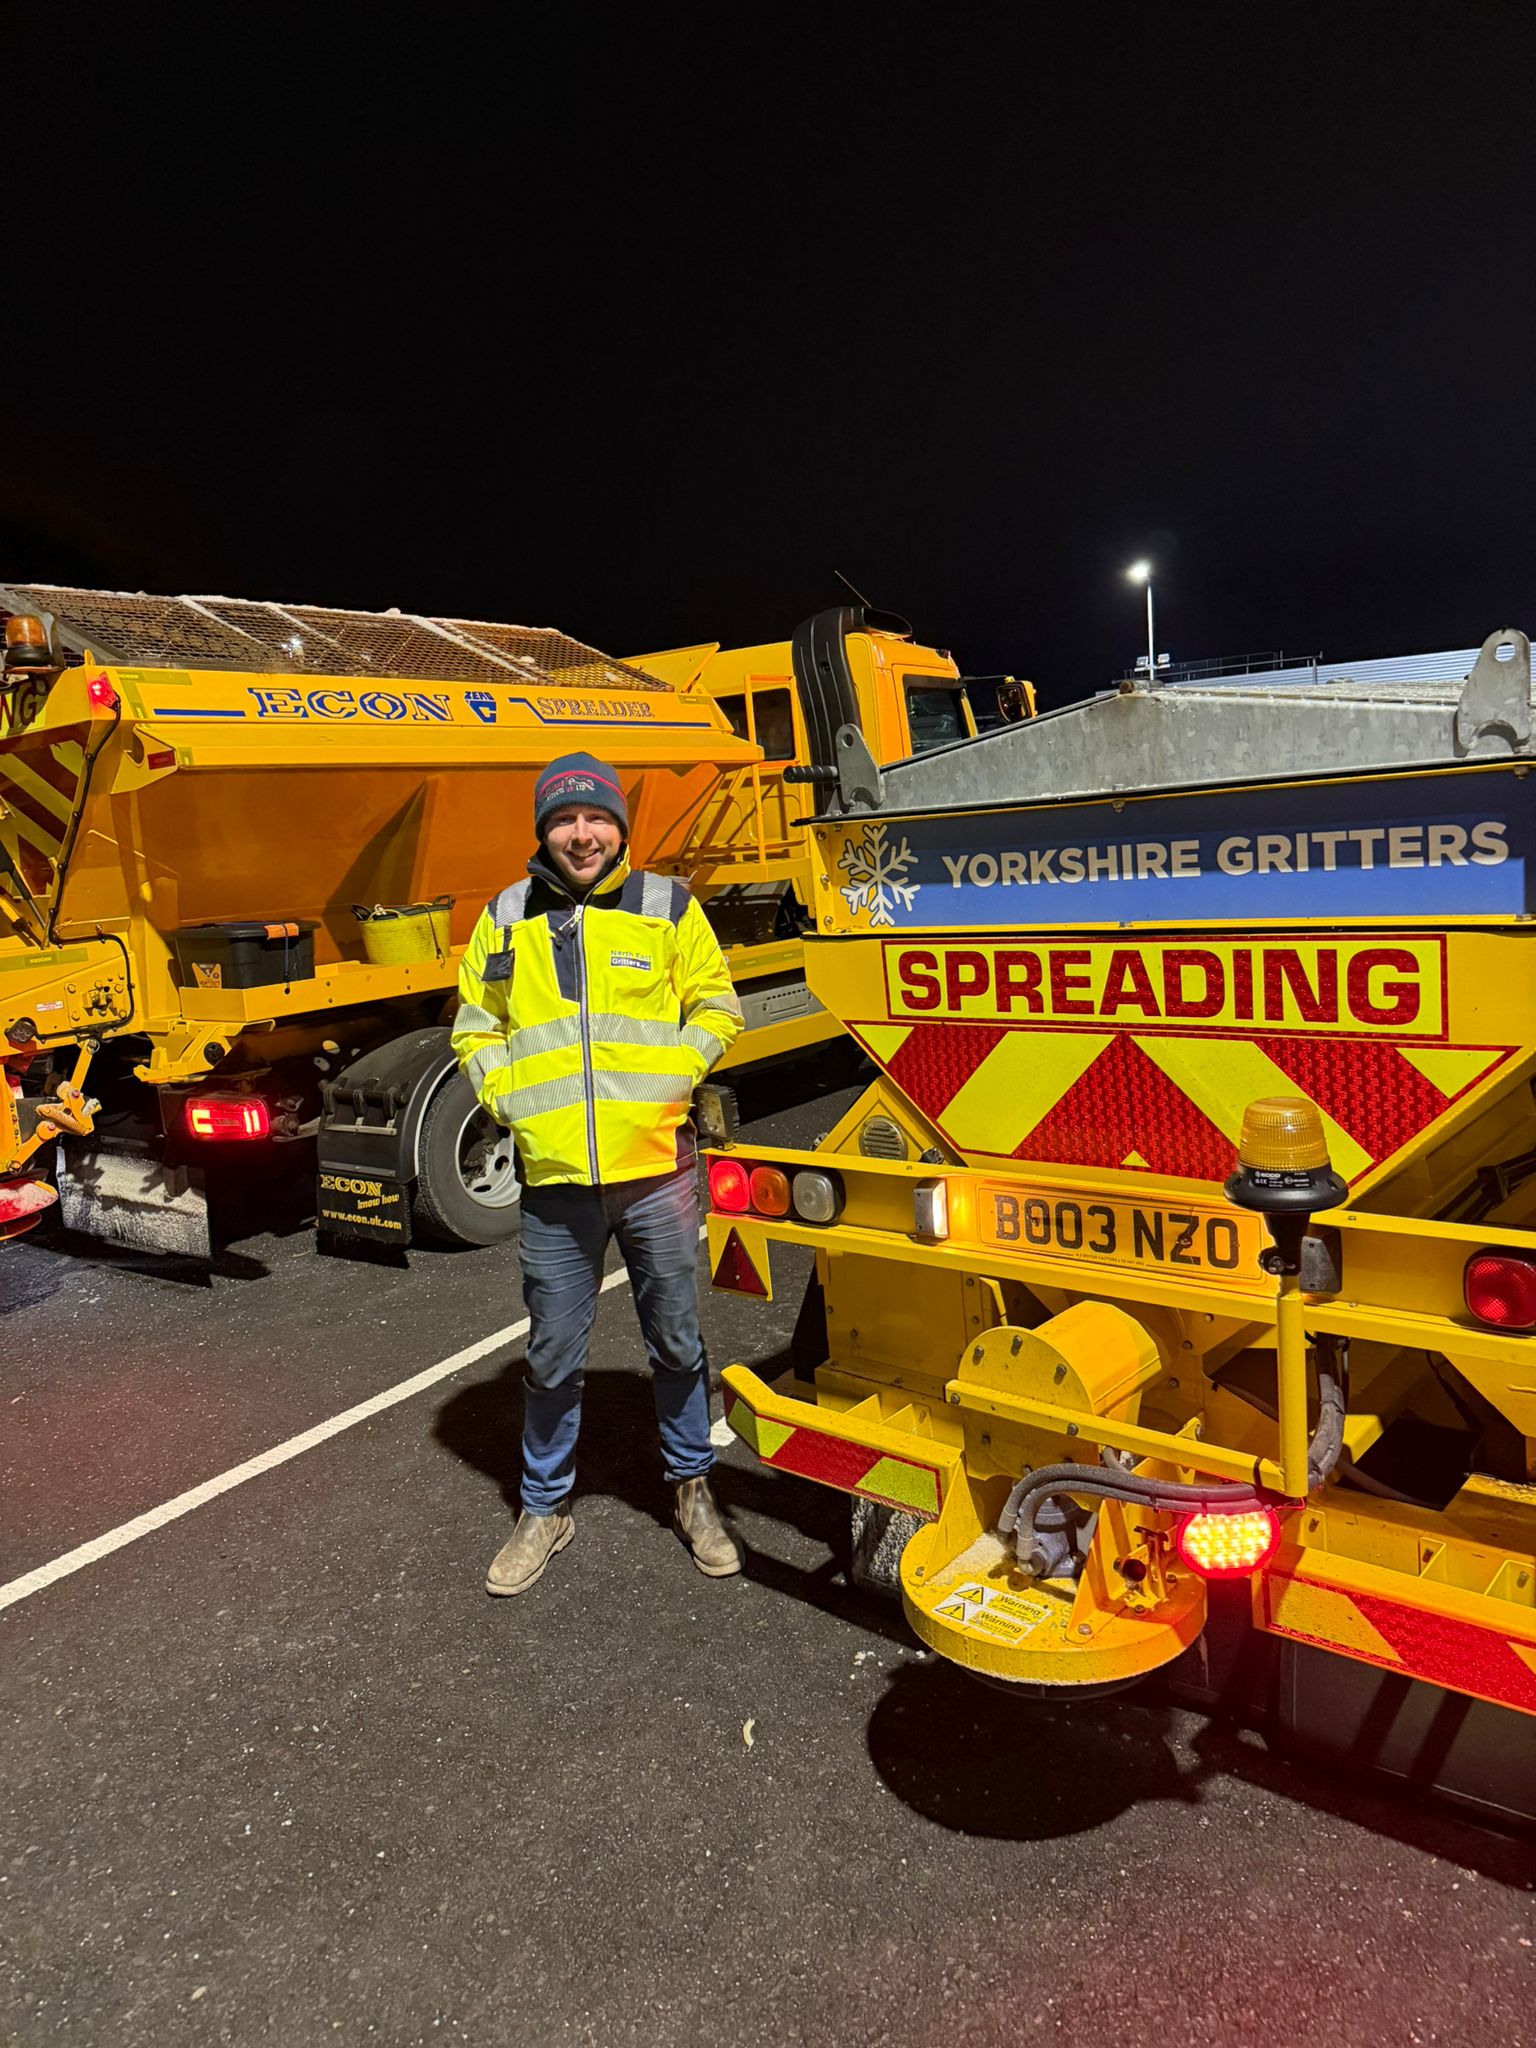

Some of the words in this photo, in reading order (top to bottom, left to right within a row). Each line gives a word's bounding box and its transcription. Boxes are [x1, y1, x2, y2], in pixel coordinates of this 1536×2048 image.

[247, 687, 454, 722] ECON
[536, 695, 655, 718] SPREADER
[941, 839, 1201, 889] YORKSHIRE
[1216, 821, 1510, 877] GRITTERS
[898, 947, 1421, 1026] SPREADING
[320, 1174, 382, 1197] ECON
[357, 1198, 380, 1210] know
[381, 1194, 400, 1205] how
[322, 1209, 402, 1230] www.econ.uk.com
[1132, 1208, 1240, 1270] NZO
[1000, 1595, 1041, 1616] Warning
[981, 1612, 1022, 1634] Warning
